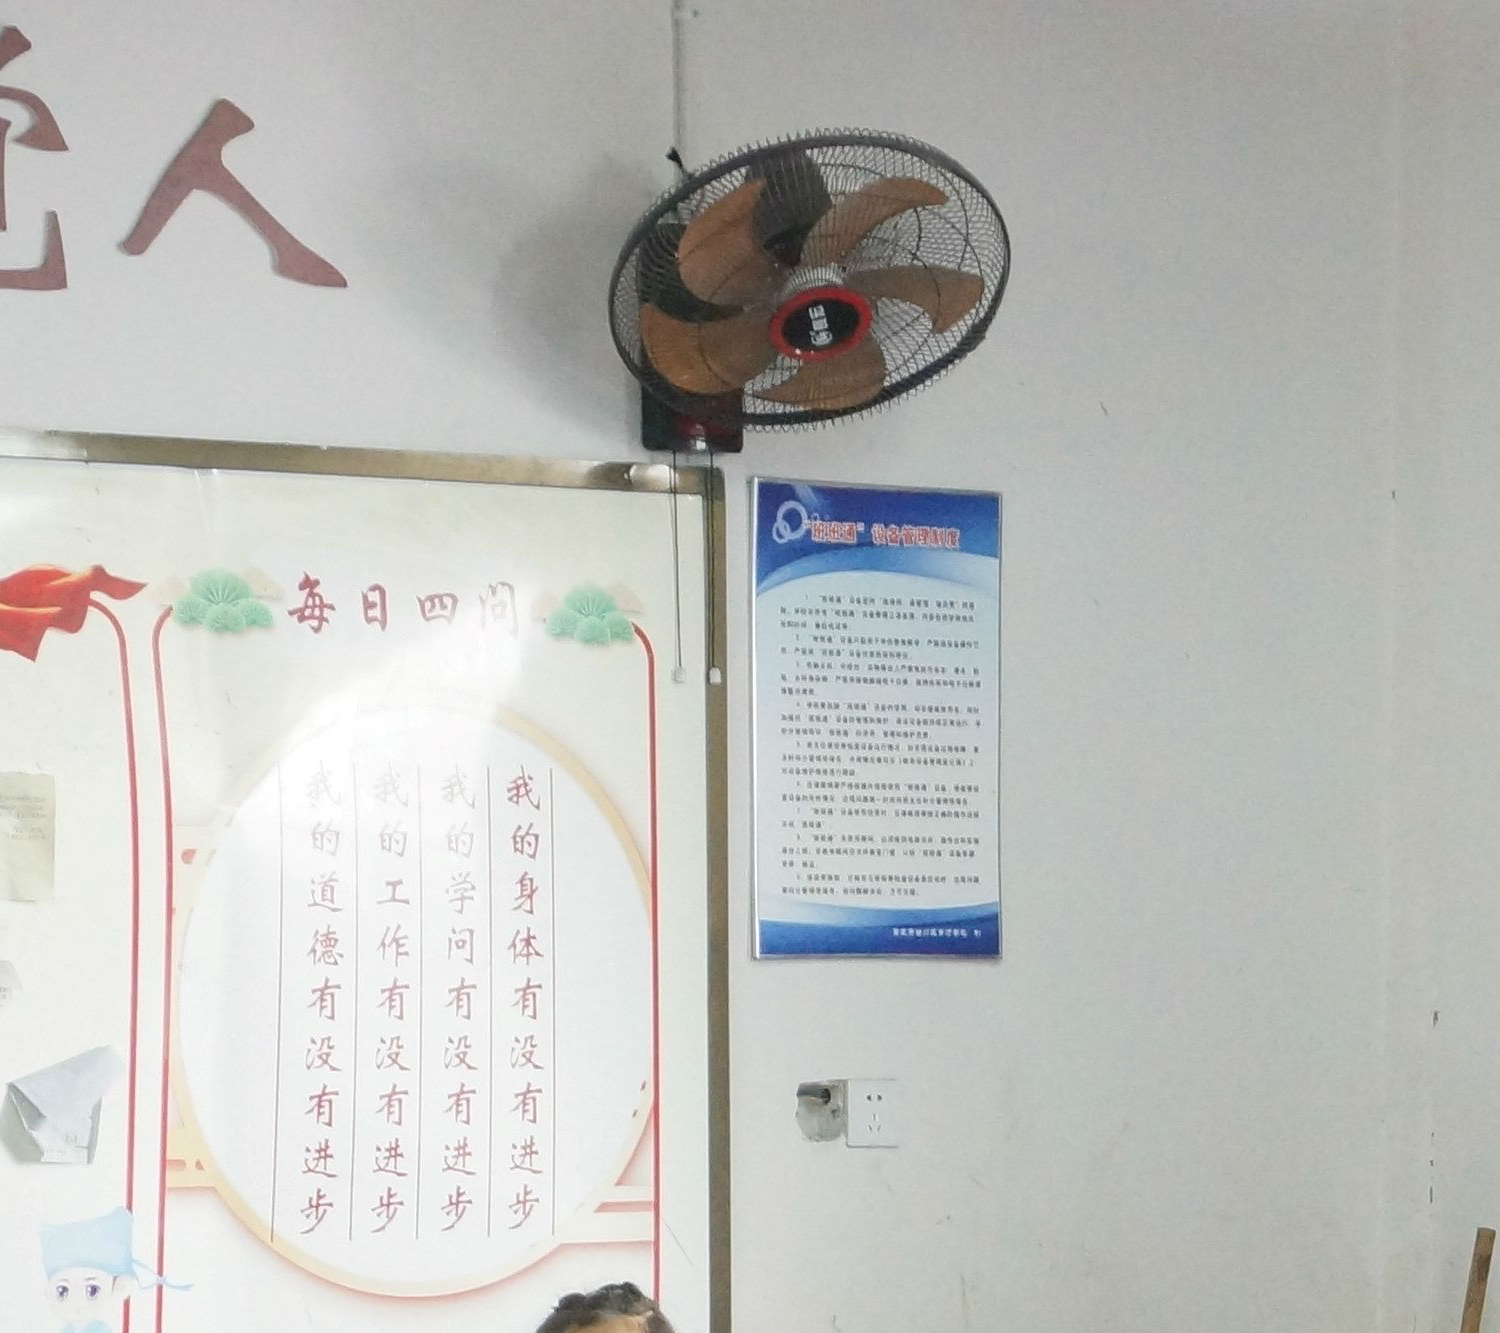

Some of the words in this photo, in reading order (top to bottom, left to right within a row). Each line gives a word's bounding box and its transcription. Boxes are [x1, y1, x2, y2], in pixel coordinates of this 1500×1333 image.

[287, 571, 520, 637] 每日四问
[300, 762, 344, 1235] 我的道德有没有进步
[371, 763, 411, 1234] 我的工作有没有进步
[440, 763, 478, 1233] 我的学问有没有进步
[506, 764, 545, 1231] 我的身体有没有进步
